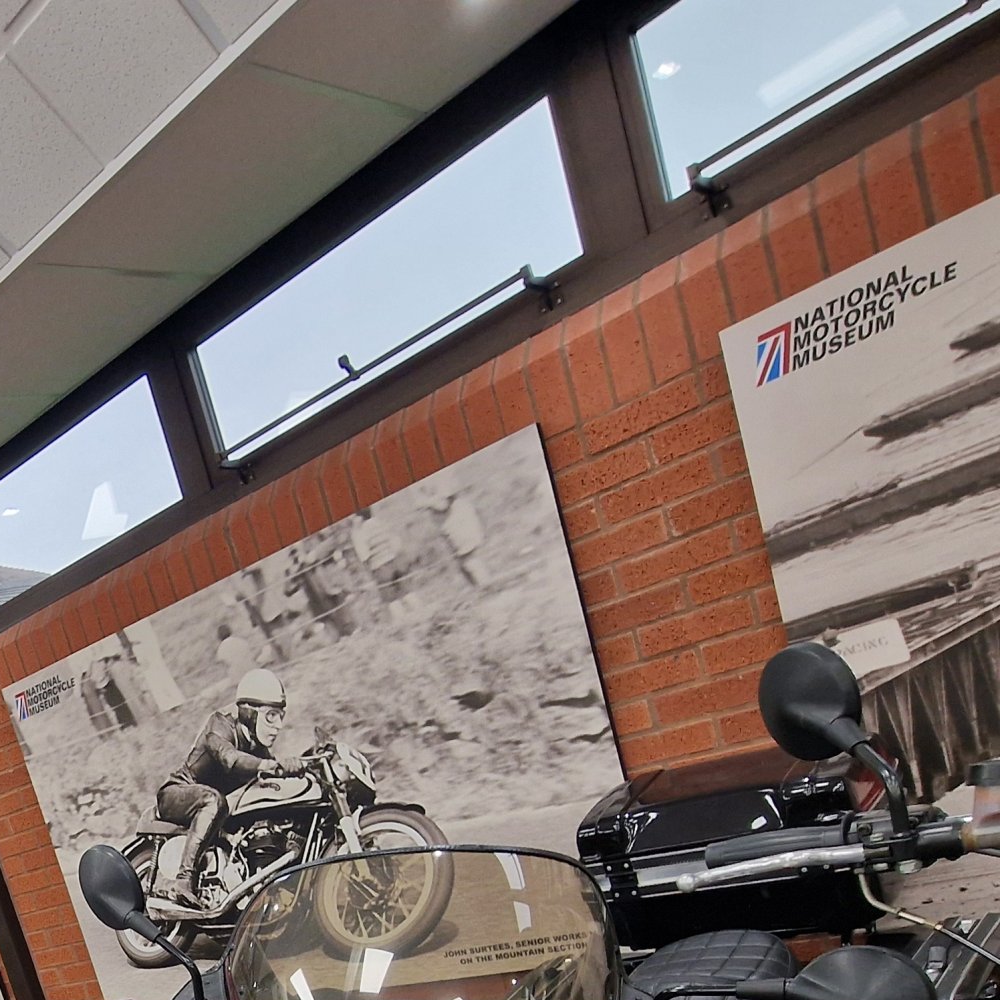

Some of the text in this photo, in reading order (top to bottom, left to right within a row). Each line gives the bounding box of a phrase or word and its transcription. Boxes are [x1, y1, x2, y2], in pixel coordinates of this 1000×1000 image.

[793, 261, 958, 352] MOTORCYCLE
[794, 265, 913, 334] NATIONAL
[792, 311, 895, 371] MUSEUM
[26, 675, 61, 697] NATIONAL
[27, 677, 75, 706] MOTORCYCLE
[29, 695, 60, 716] MUSEUM
[443, 949, 467, 959] JOHN
[469, 942, 514, 956] SURTEES,
[515, 936, 551, 948] SENIOR
[552, 931, 588, 943] WORKS
[475, 954, 493, 963] THE
[495, 948, 545, 961] MOUNTAIN
[547, 942, 588, 954] SECTION
